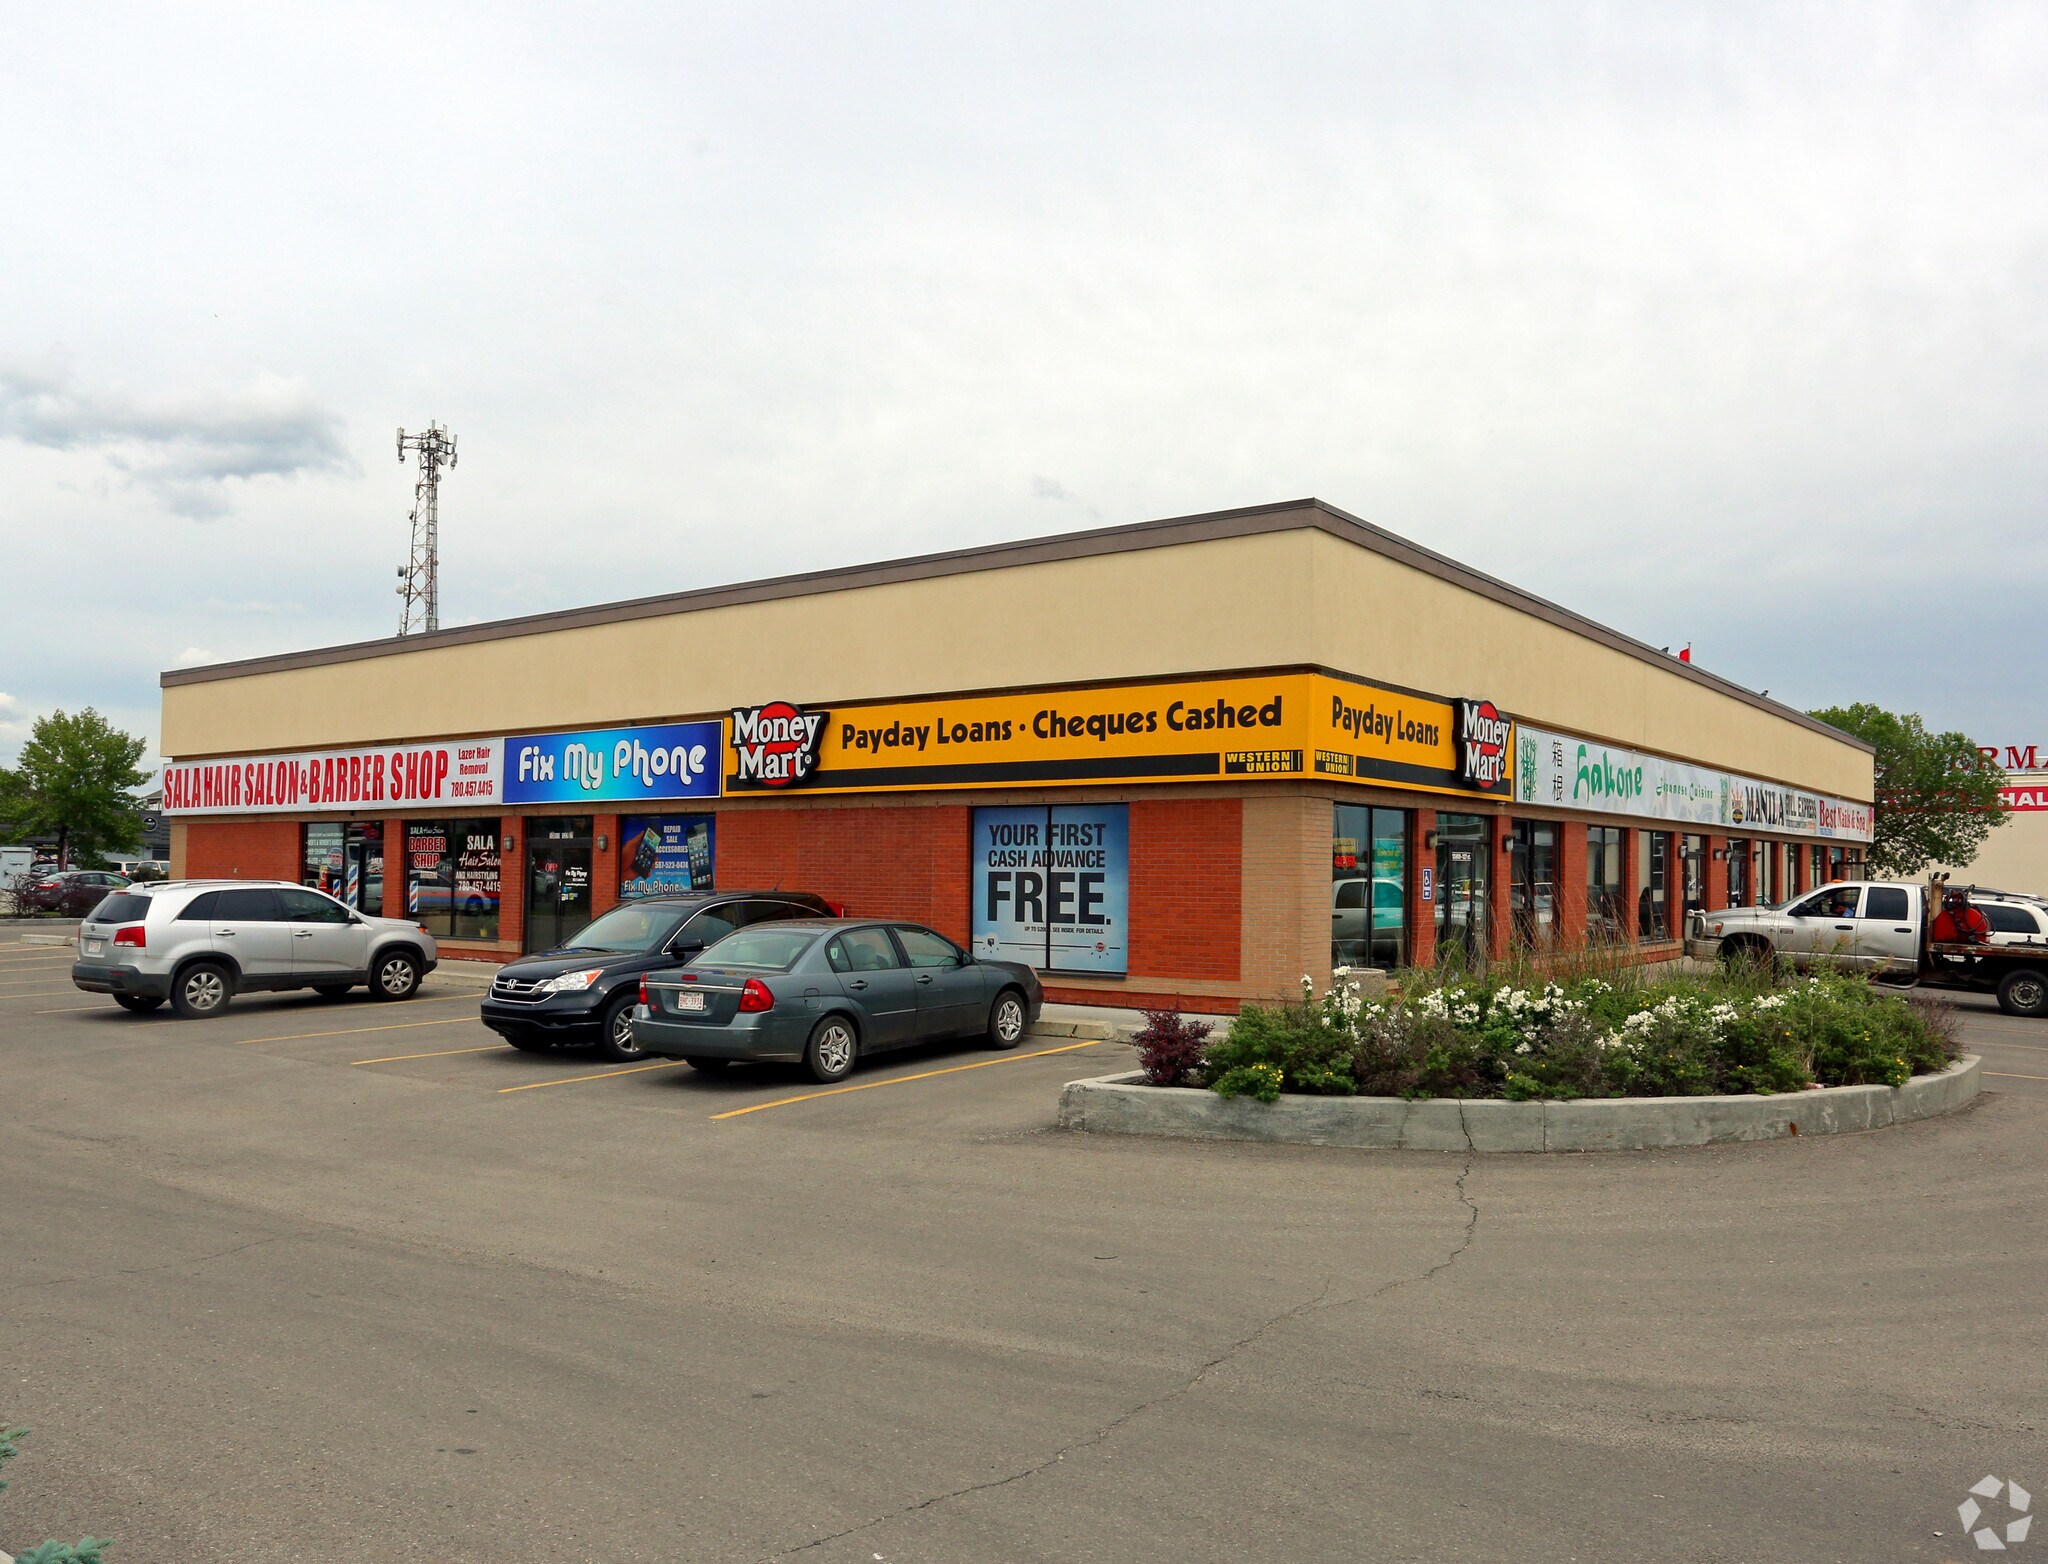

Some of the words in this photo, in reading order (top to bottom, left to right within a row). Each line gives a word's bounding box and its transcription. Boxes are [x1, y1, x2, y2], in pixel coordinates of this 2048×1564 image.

[842, 720, 930, 754] Payday
[937, 718, 1012, 744] Loans
[1032, 706, 1157, 742] Cheques
[1166, 695, 1283, 731] Cashed
[1332, 695, 1393, 744] Payday
[1397, 710, 1439, 746] Loans
[733, 709, 821, 751] Money
[1462, 702, 1510, 757] Money
[458, 748, 475, 760] Lazer
[476, 747, 491, 759] Hair
[1226, 750, 1290, 764] WESTERN
[1315, 750, 1348, 765] WESTERN
[459, 762, 488, 775] Removal
[519, 745, 555, 783] Fix
[563, 743, 603, 790] My
[613, 738, 707, 787] Phone
[739, 746, 805, 780] Mart
[1246, 762, 1290, 773] UNION
[1325, 762, 1348, 774] UNION
[1465, 742, 1501, 783] Mart
[164, 767, 200, 810] SALA
[204, 764, 241, 807] HAIR
[245, 760, 299, 807] SALON
[300, 768, 308, 795] &
[308, 754, 384, 804] BARBER
[390, 749, 449, 801] SHOP
[451, 780, 493, 798] 780.457.4415
[1745, 785, 1785, 827] MANILA
[1819, 799, 1837, 829] Best
[1838, 806, 1850, 828] Nails
[1856, 810, 1866, 834] Spa
[410, 826, 423, 835] SALA
[663, 825, 681, 833] REPAIR
[988, 823, 1039, 847] YOUR
[1046, 823, 1106, 847] FIRST
[408, 836, 447, 853] BARBER
[467, 835, 494, 850] SALA
[666, 835, 678, 843] SALE
[655, 845, 689, 853] ACCESSORIES
[414, 852, 440, 869] SHOP
[459, 851, 479, 867] Hair
[478, 851, 501, 867] Salon
[988, 849, 1027, 868] CASH
[1031, 849, 1106, 868] ADVANCE
[455, 871, 466, 880] AND
[466, 871, 498, 880] HAIRSTYLING
[624, 880, 635, 892] Fix
[638, 880, 650, 894] My
[653, 880, 679, 893] Phone
[987, 871, 1112, 925] FREE.
